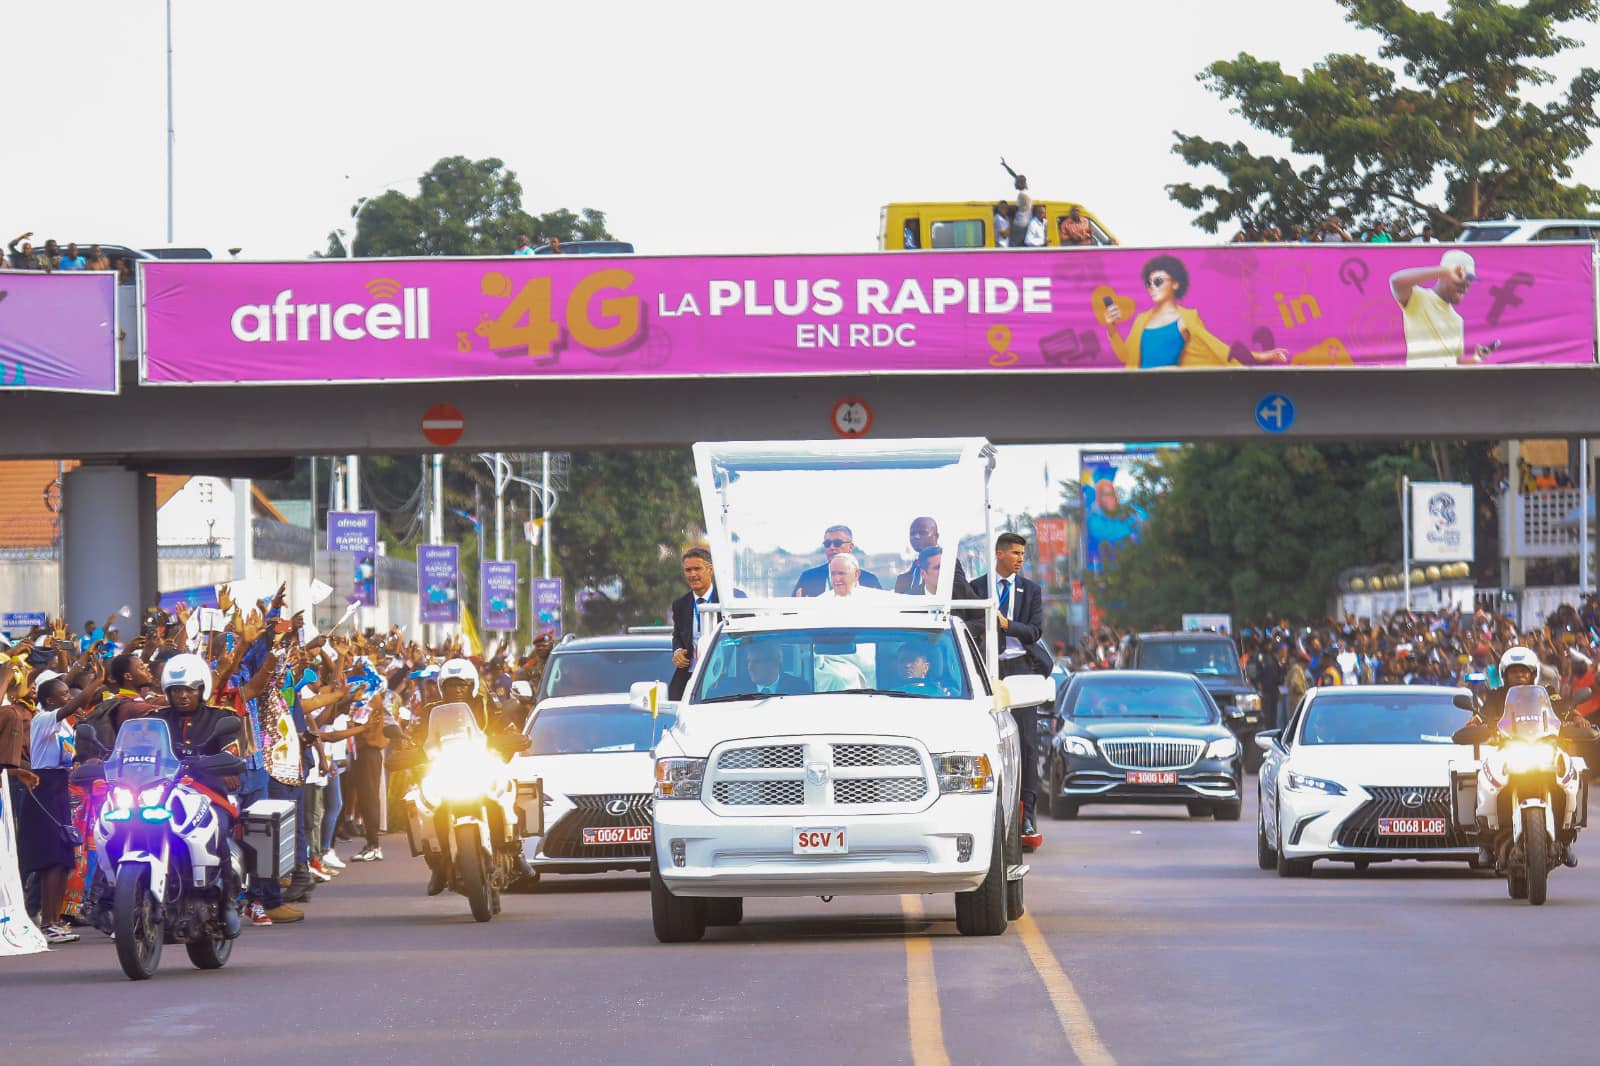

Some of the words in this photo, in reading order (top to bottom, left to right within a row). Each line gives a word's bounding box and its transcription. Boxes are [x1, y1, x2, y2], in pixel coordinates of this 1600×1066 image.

[658, 292, 701, 317] LA
[708, 279, 844, 316] PLUS
[857, 277, 1053, 315] RAPIDE
[230, 287, 430, 343] africell
[488, 268, 641, 357] 4G
[796, 324, 840, 348] EN
[849, 323, 917, 347] RDC
[123, 756, 156, 764] POLICE
[597, 829, 624, 842] 0067
[626, 828, 648, 841] LOG
[1393, 820, 1419, 833] 0068
[1421, 820, 1442, 833] LOG
[798, 832, 831, 848] SCV
[836, 831, 844, 848] 1
